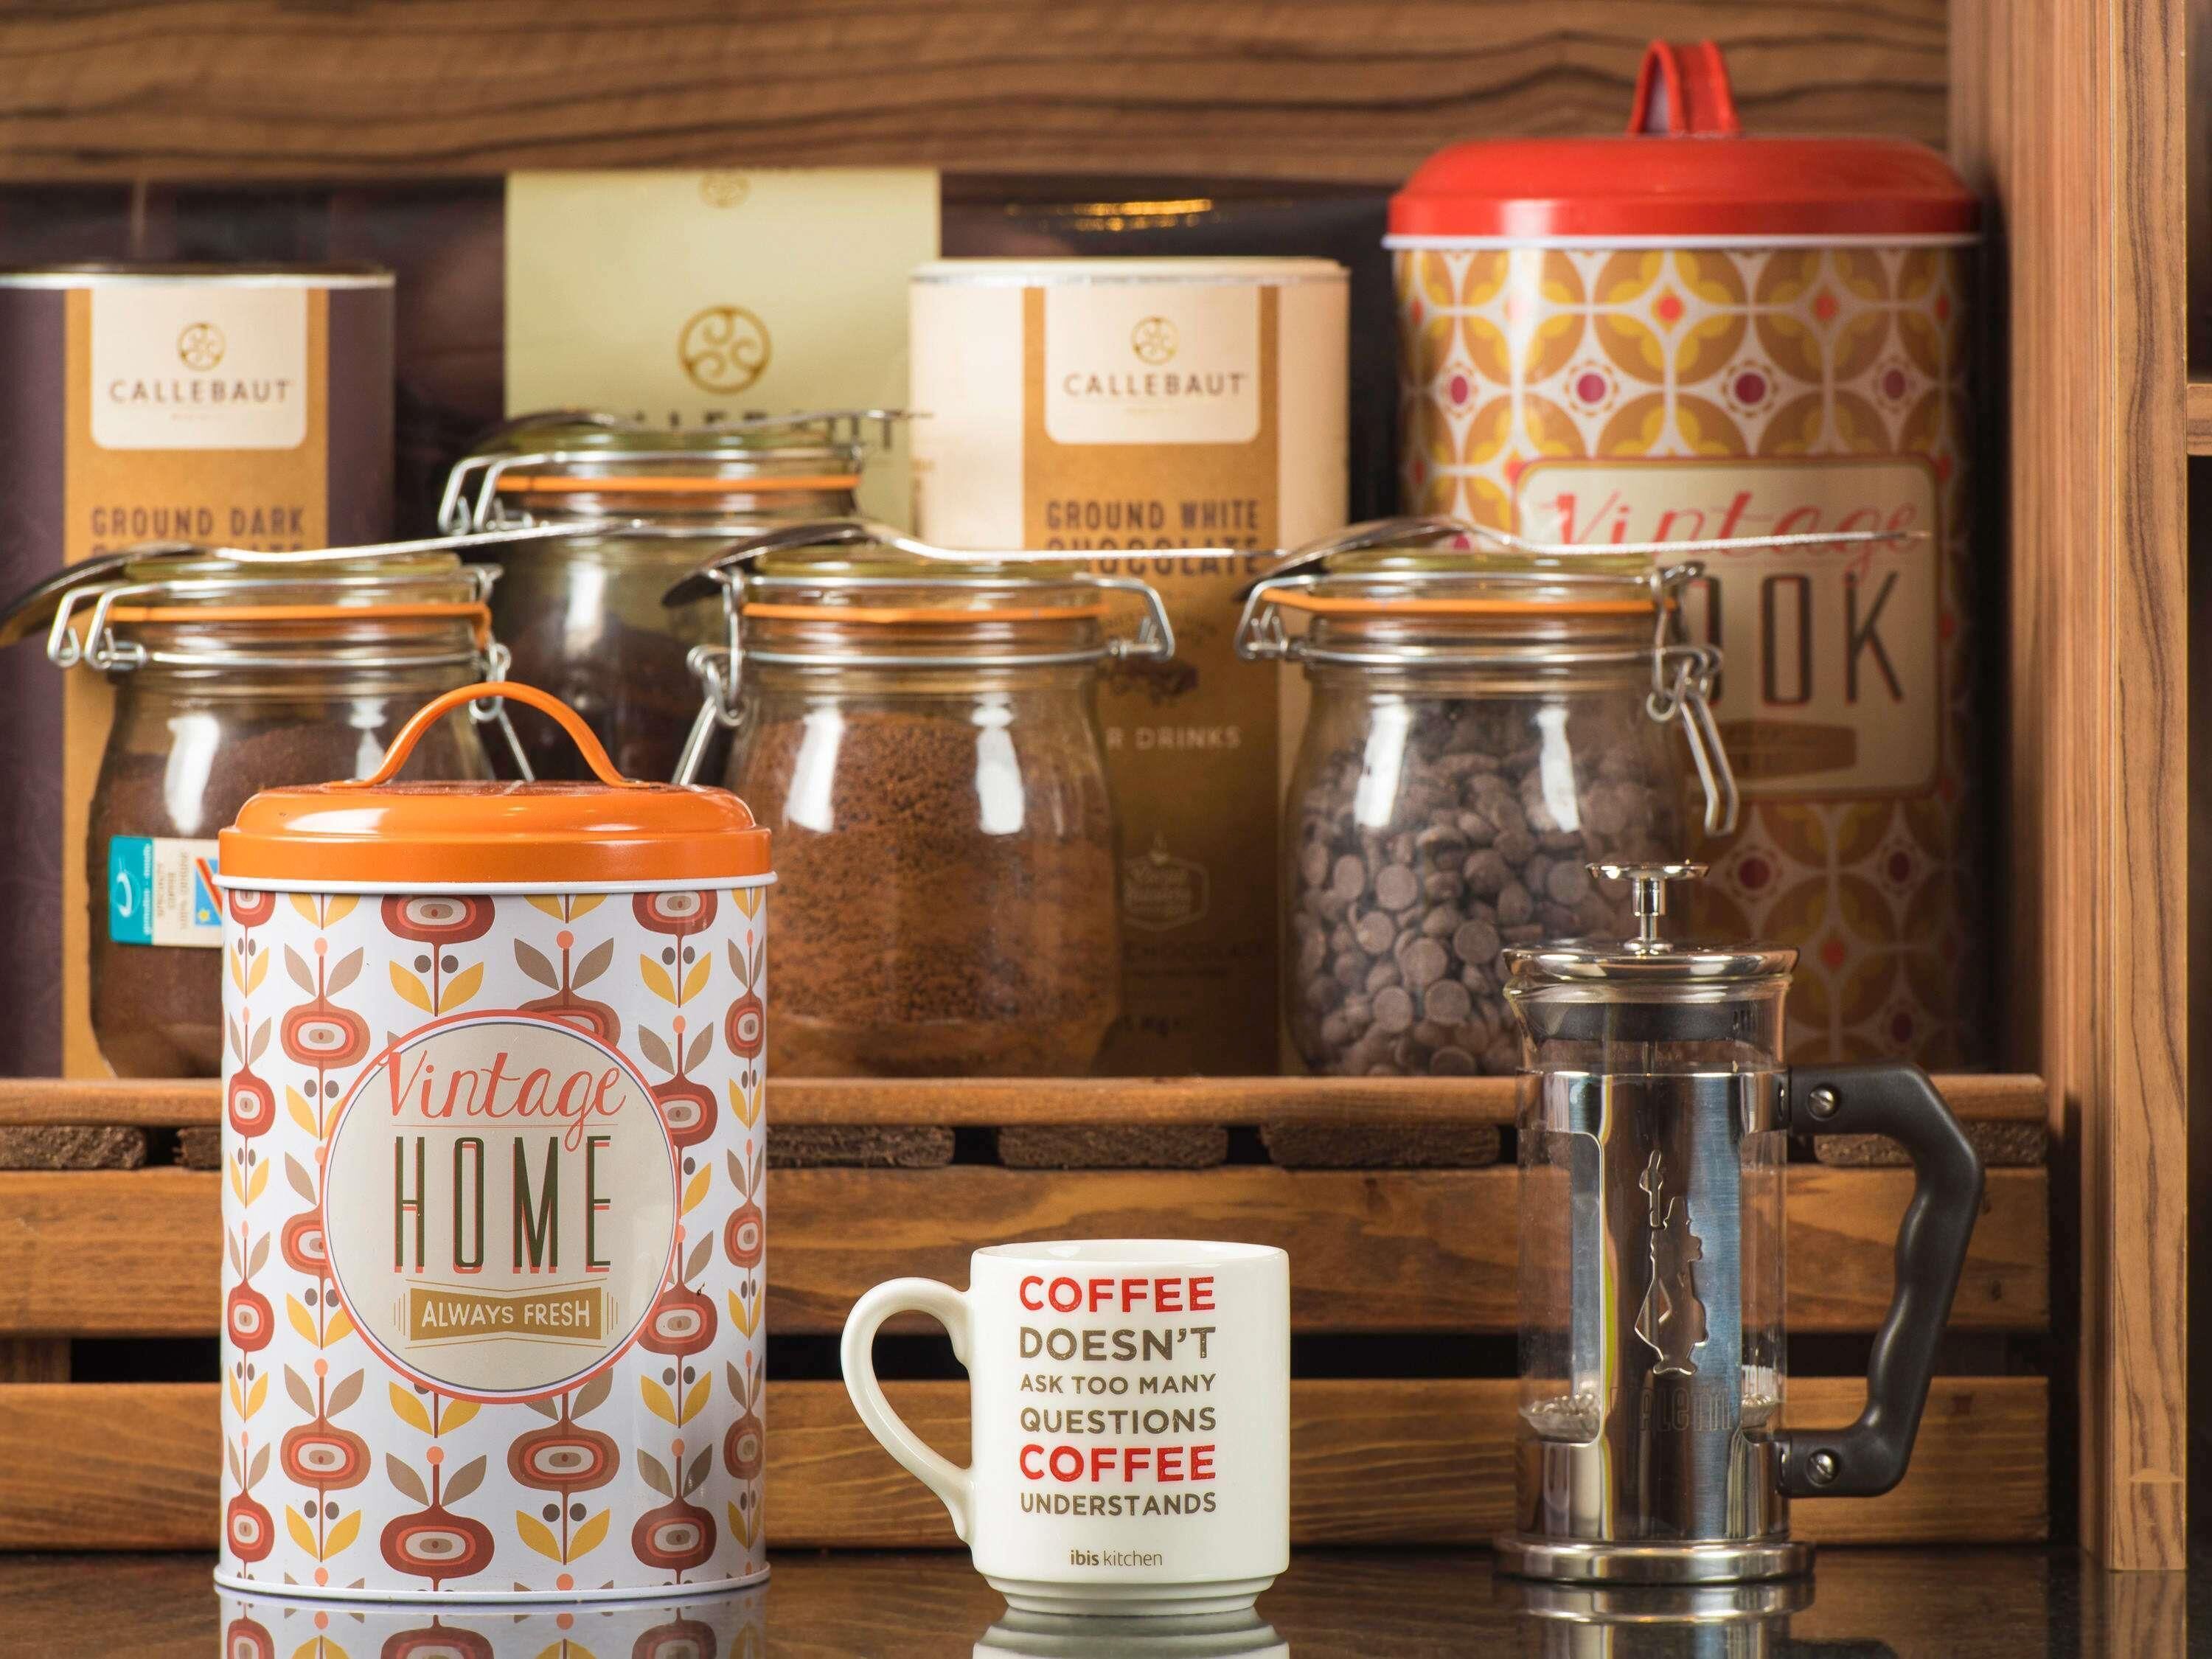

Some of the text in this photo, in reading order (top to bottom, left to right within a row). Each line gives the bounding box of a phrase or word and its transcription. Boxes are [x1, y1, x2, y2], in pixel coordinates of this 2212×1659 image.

[109, 378, 290, 404] CALLEBAUT
[1063, 372, 1244, 398] CALLEBAUT
[91, 506, 305, 538] GROUND DARK
[1046, 498, 1260, 531] GROUND WHITE
[1544, 490, 1919, 580] Vintage
[1135, 726, 1242, 751] DRINKS
[378, 1050, 627, 1152] Vintage
[393, 1135, 611, 1274] HOME
[1020, 1276, 1216, 1312] COFFEE
[421, 1300, 591, 1328] ALWAYS FRESH
[1020, 1326, 1217, 1361] DOESN'T
[1020, 1373, 1217, 1395] ASK TOO MANY
[1020, 1407, 1217, 1434] QUESTIONS
[1020, 1444, 1216, 1483] COFFEE
[1020, 1492, 1217, 1516] UNDERSTANDS
[1071, 1549, 1163, 1567] ibis kitchen
